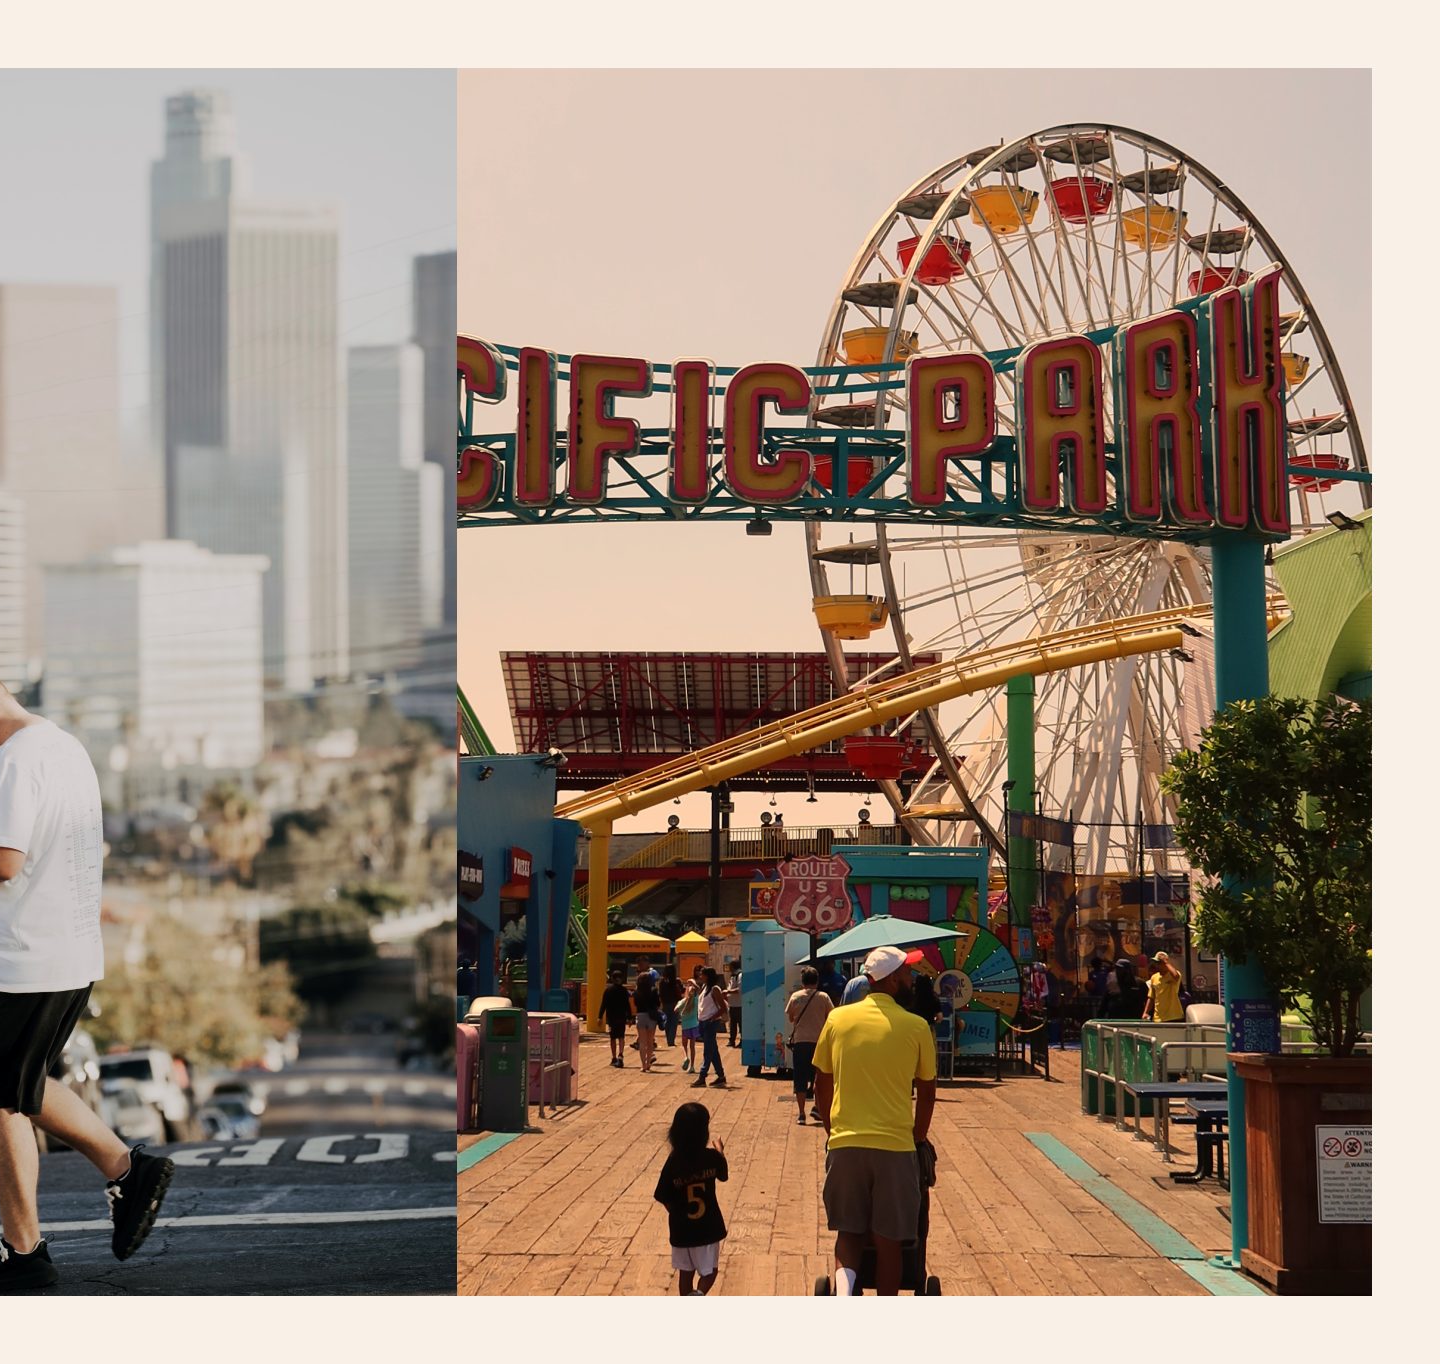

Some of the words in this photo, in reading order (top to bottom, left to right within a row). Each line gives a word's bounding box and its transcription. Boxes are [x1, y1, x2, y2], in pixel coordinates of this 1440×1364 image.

[905, 262, 1290, 537] PARK
[788, 861, 839, 877] ROUTE
[790, 895, 837, 926] 66
[687, 1183, 706, 1219] 5
